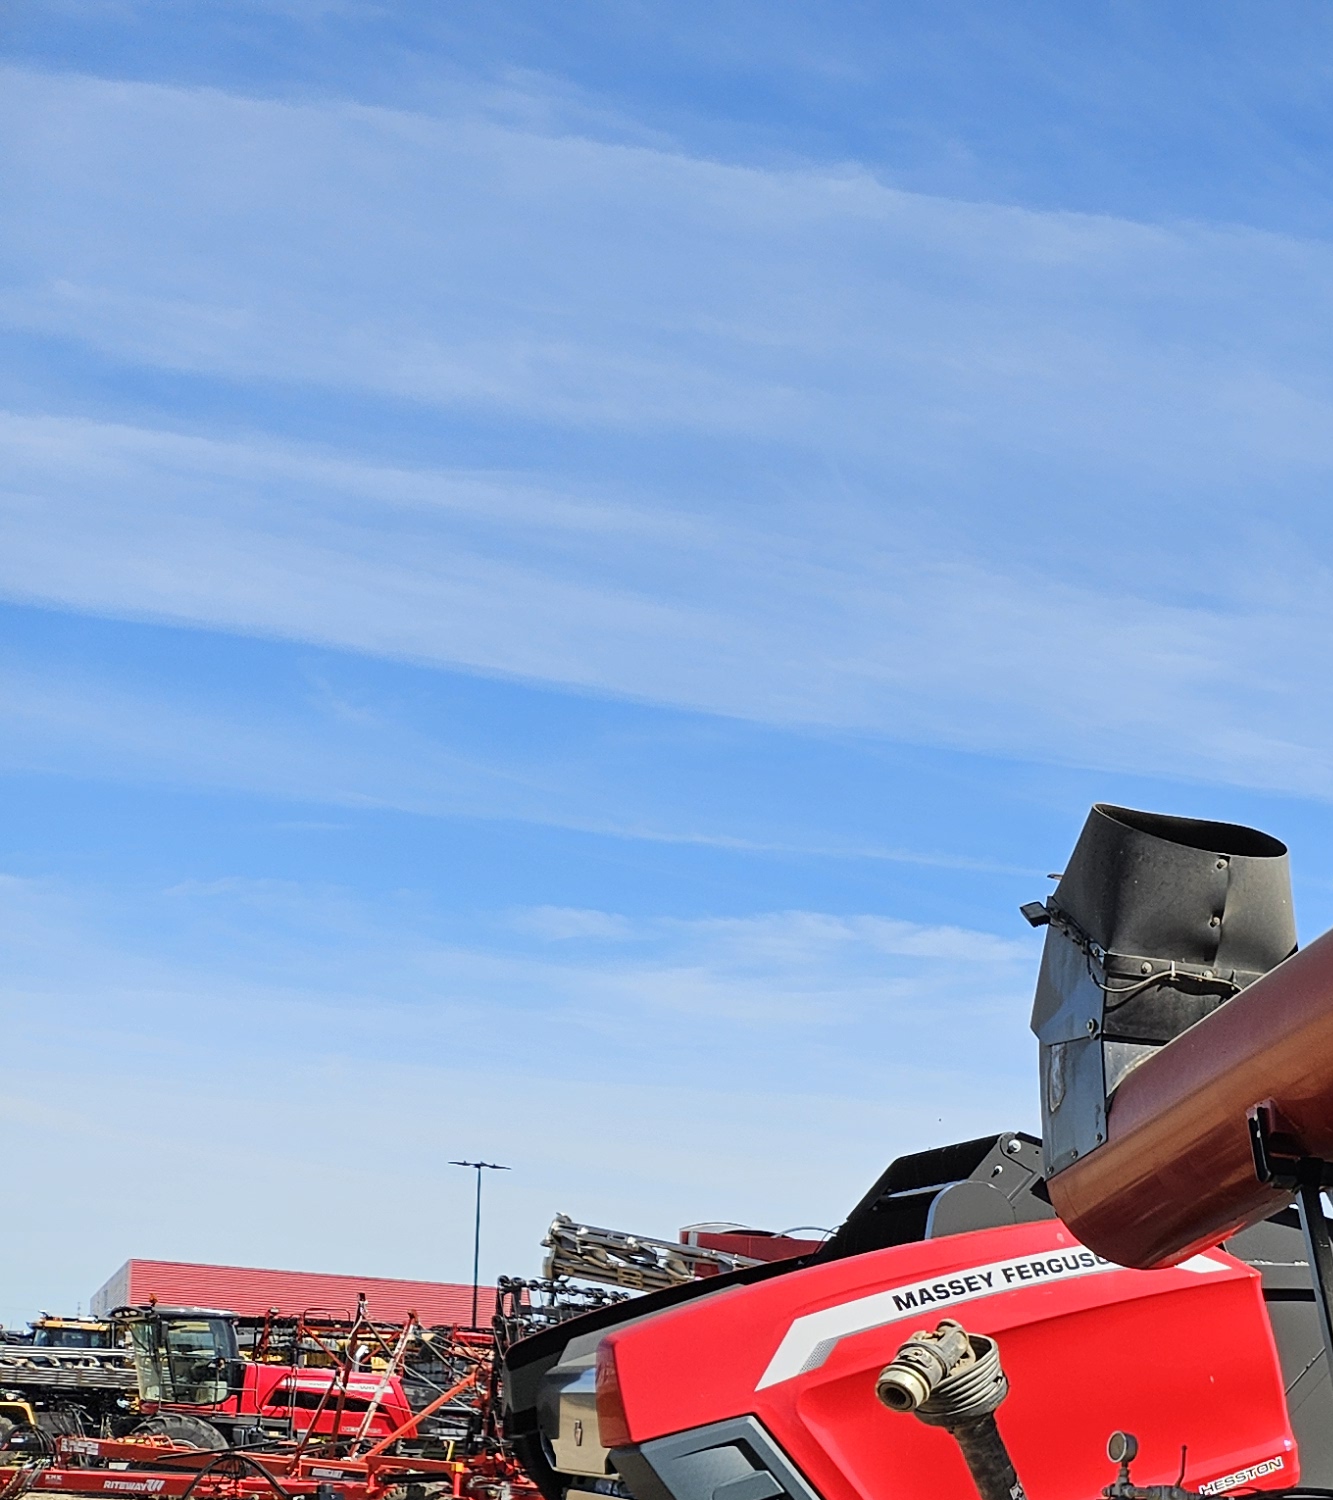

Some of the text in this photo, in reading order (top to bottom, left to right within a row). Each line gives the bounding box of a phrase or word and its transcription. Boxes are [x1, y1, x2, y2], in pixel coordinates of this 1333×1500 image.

[892, 1271, 994, 1311] MASSEY
[103, 1479, 148, 1492] RITEWAY
[1199, 1456, 1284, 1495] HESSTON
